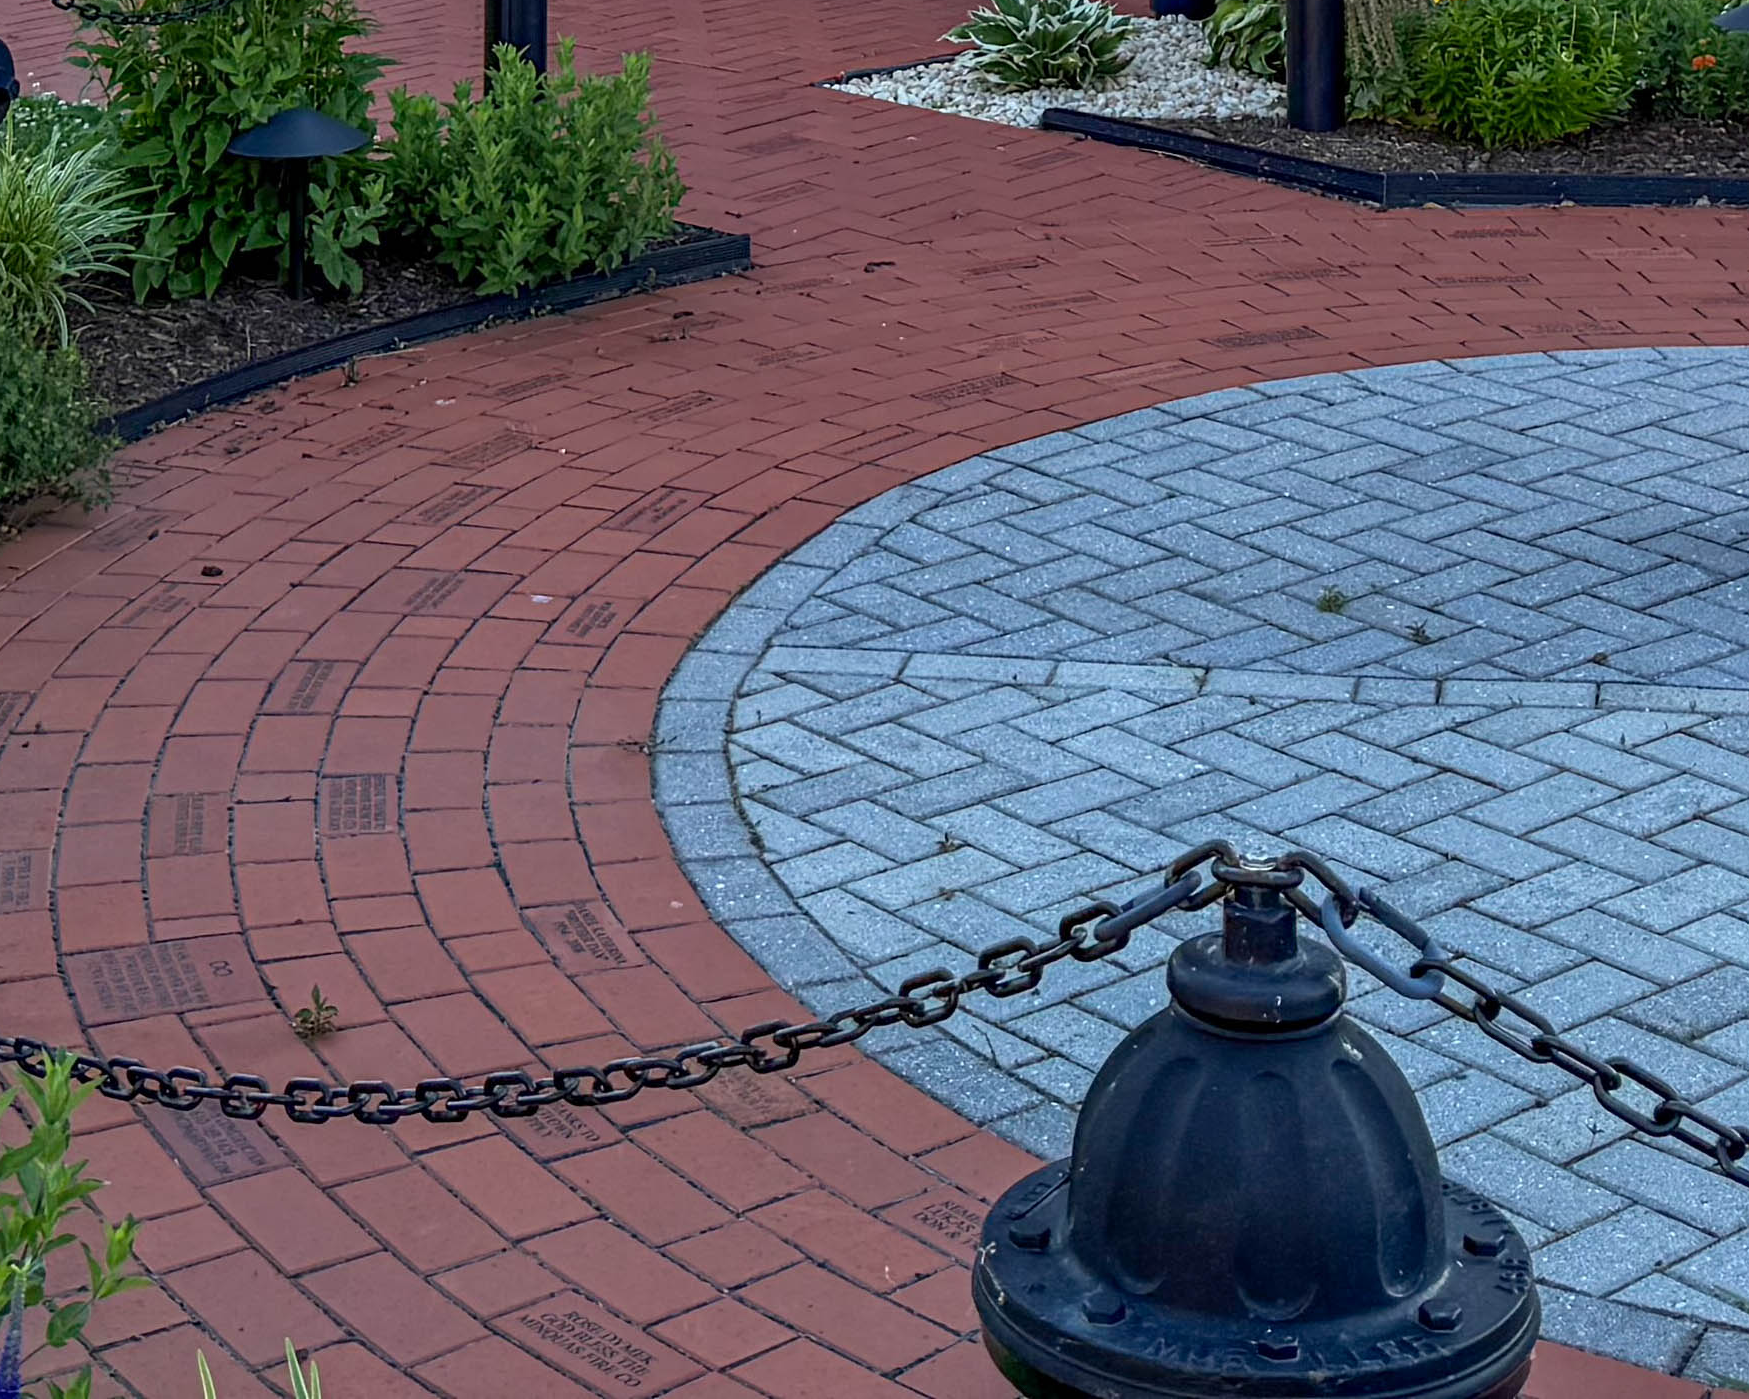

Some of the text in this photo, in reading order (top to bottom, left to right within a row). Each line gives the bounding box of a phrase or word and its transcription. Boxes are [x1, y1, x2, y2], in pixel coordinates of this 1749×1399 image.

[518, 1313, 642, 1388] MINQUAS FIRE CO
[540, 1312, 650, 1376] GOD BLESS THE
[563, 1310, 603, 1335] ROSE
